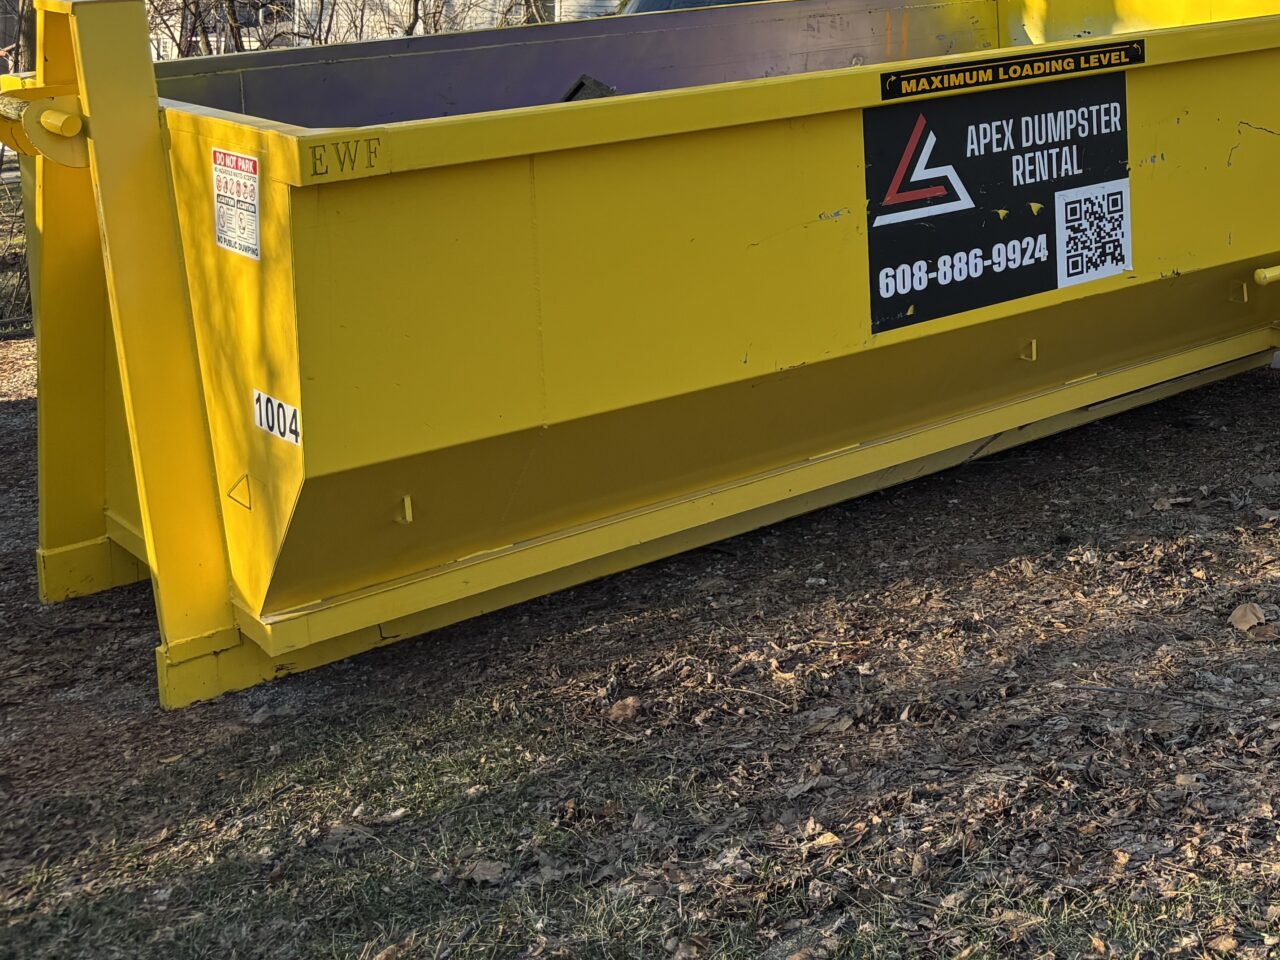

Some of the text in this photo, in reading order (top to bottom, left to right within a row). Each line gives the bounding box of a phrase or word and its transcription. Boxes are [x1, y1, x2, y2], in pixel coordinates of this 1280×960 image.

[901, 51, 1129, 93] MAXIMUM LOADING LEVEL
[966, 102, 1122, 158] APEX DUMPSTER
[216, 151, 254, 174] DO NOT PARK
[309, 138, 381, 176] EWF
[1012, 144, 1083, 186] RENTAL
[223, 236, 238, 250] PUBLIC
[239, 242, 258, 257] DUMPING
[879, 234, 1048, 299] 608-886-9924
[256, 393, 300, 443] 1004
